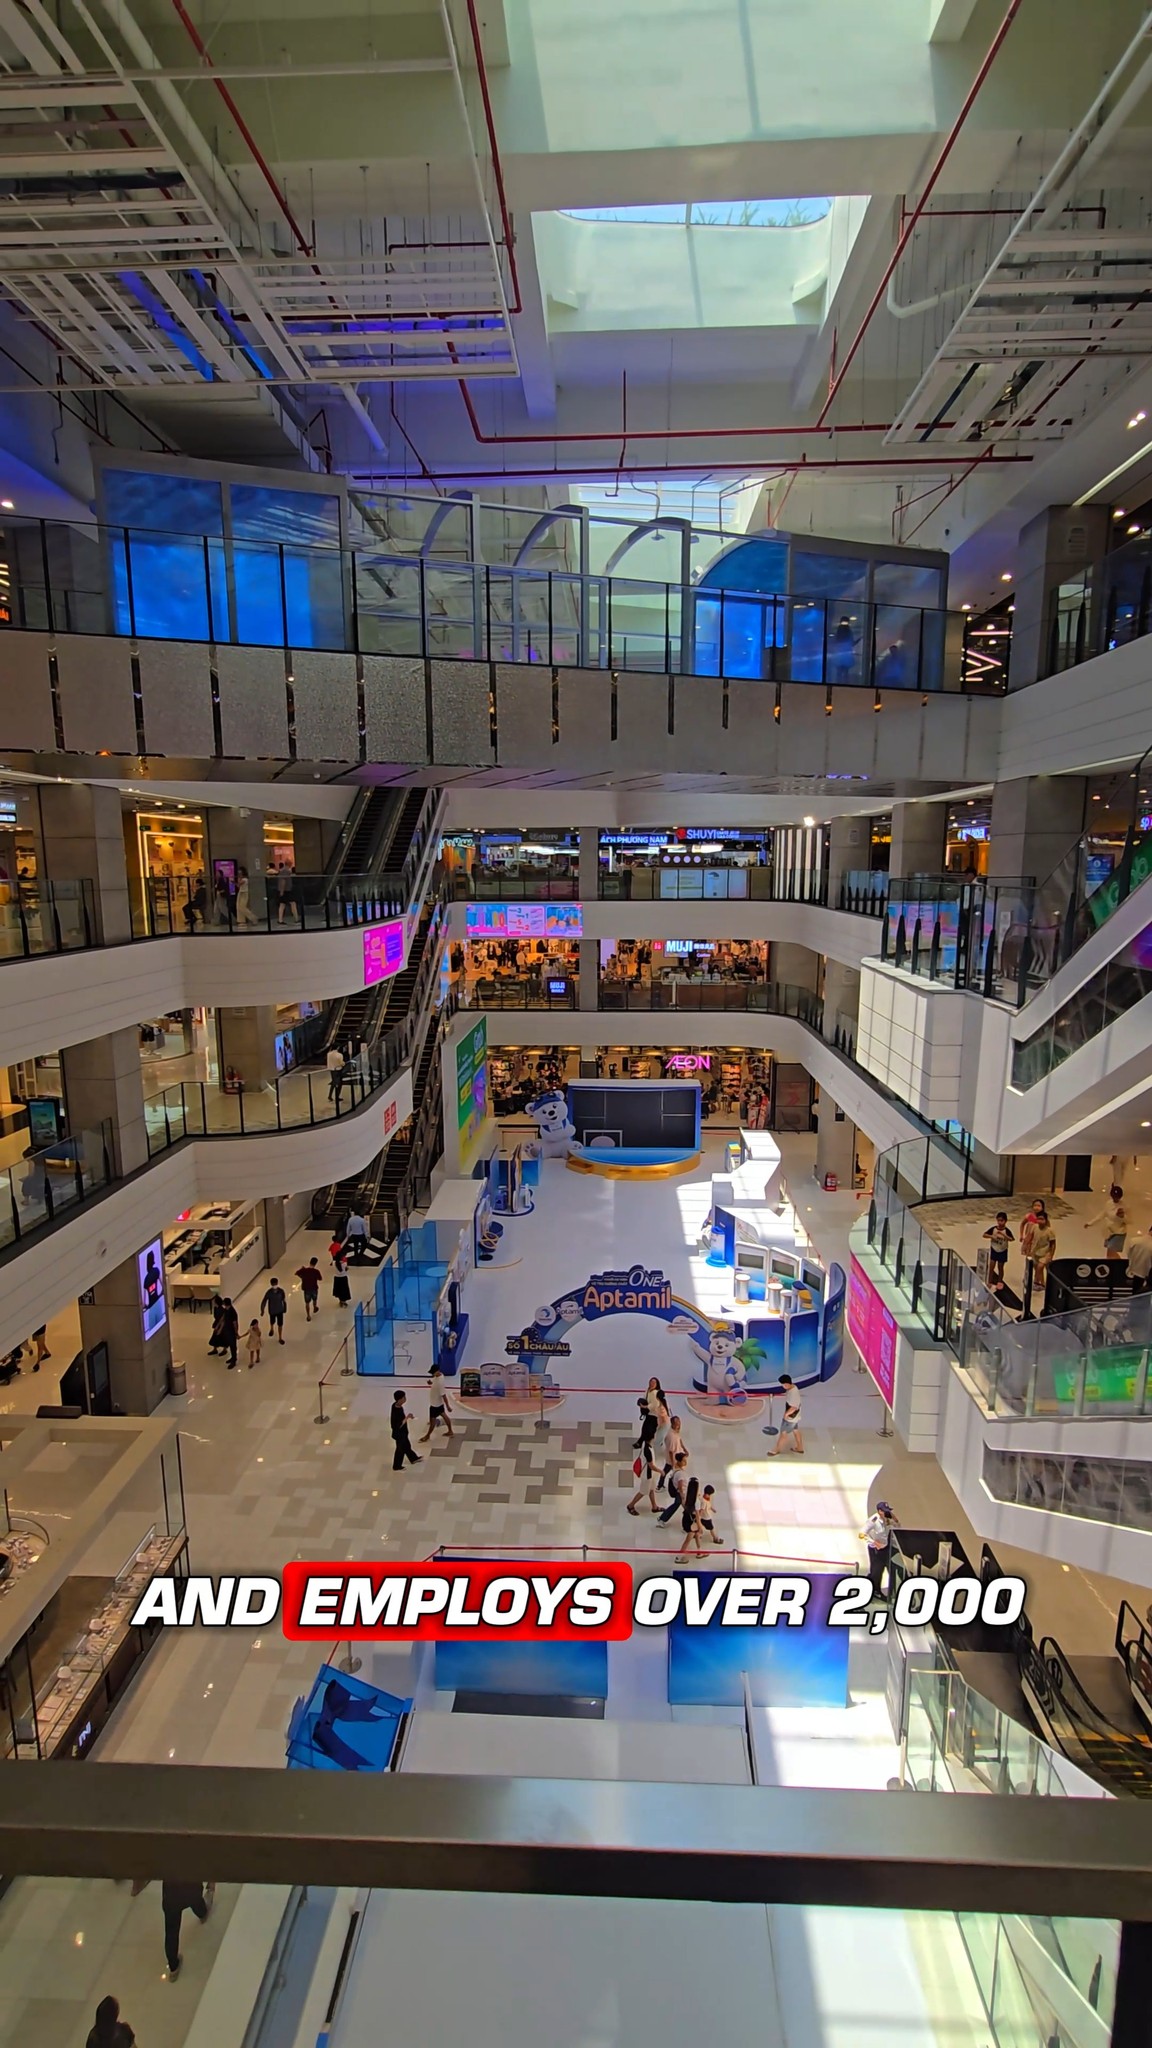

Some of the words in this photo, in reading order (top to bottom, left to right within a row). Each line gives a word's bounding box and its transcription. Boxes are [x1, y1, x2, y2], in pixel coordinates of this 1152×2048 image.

[687, 829, 716, 839] SHUYI
[666, 940, 693, 952] MUJI
[583, 1286, 671, 1312] Aptamil
